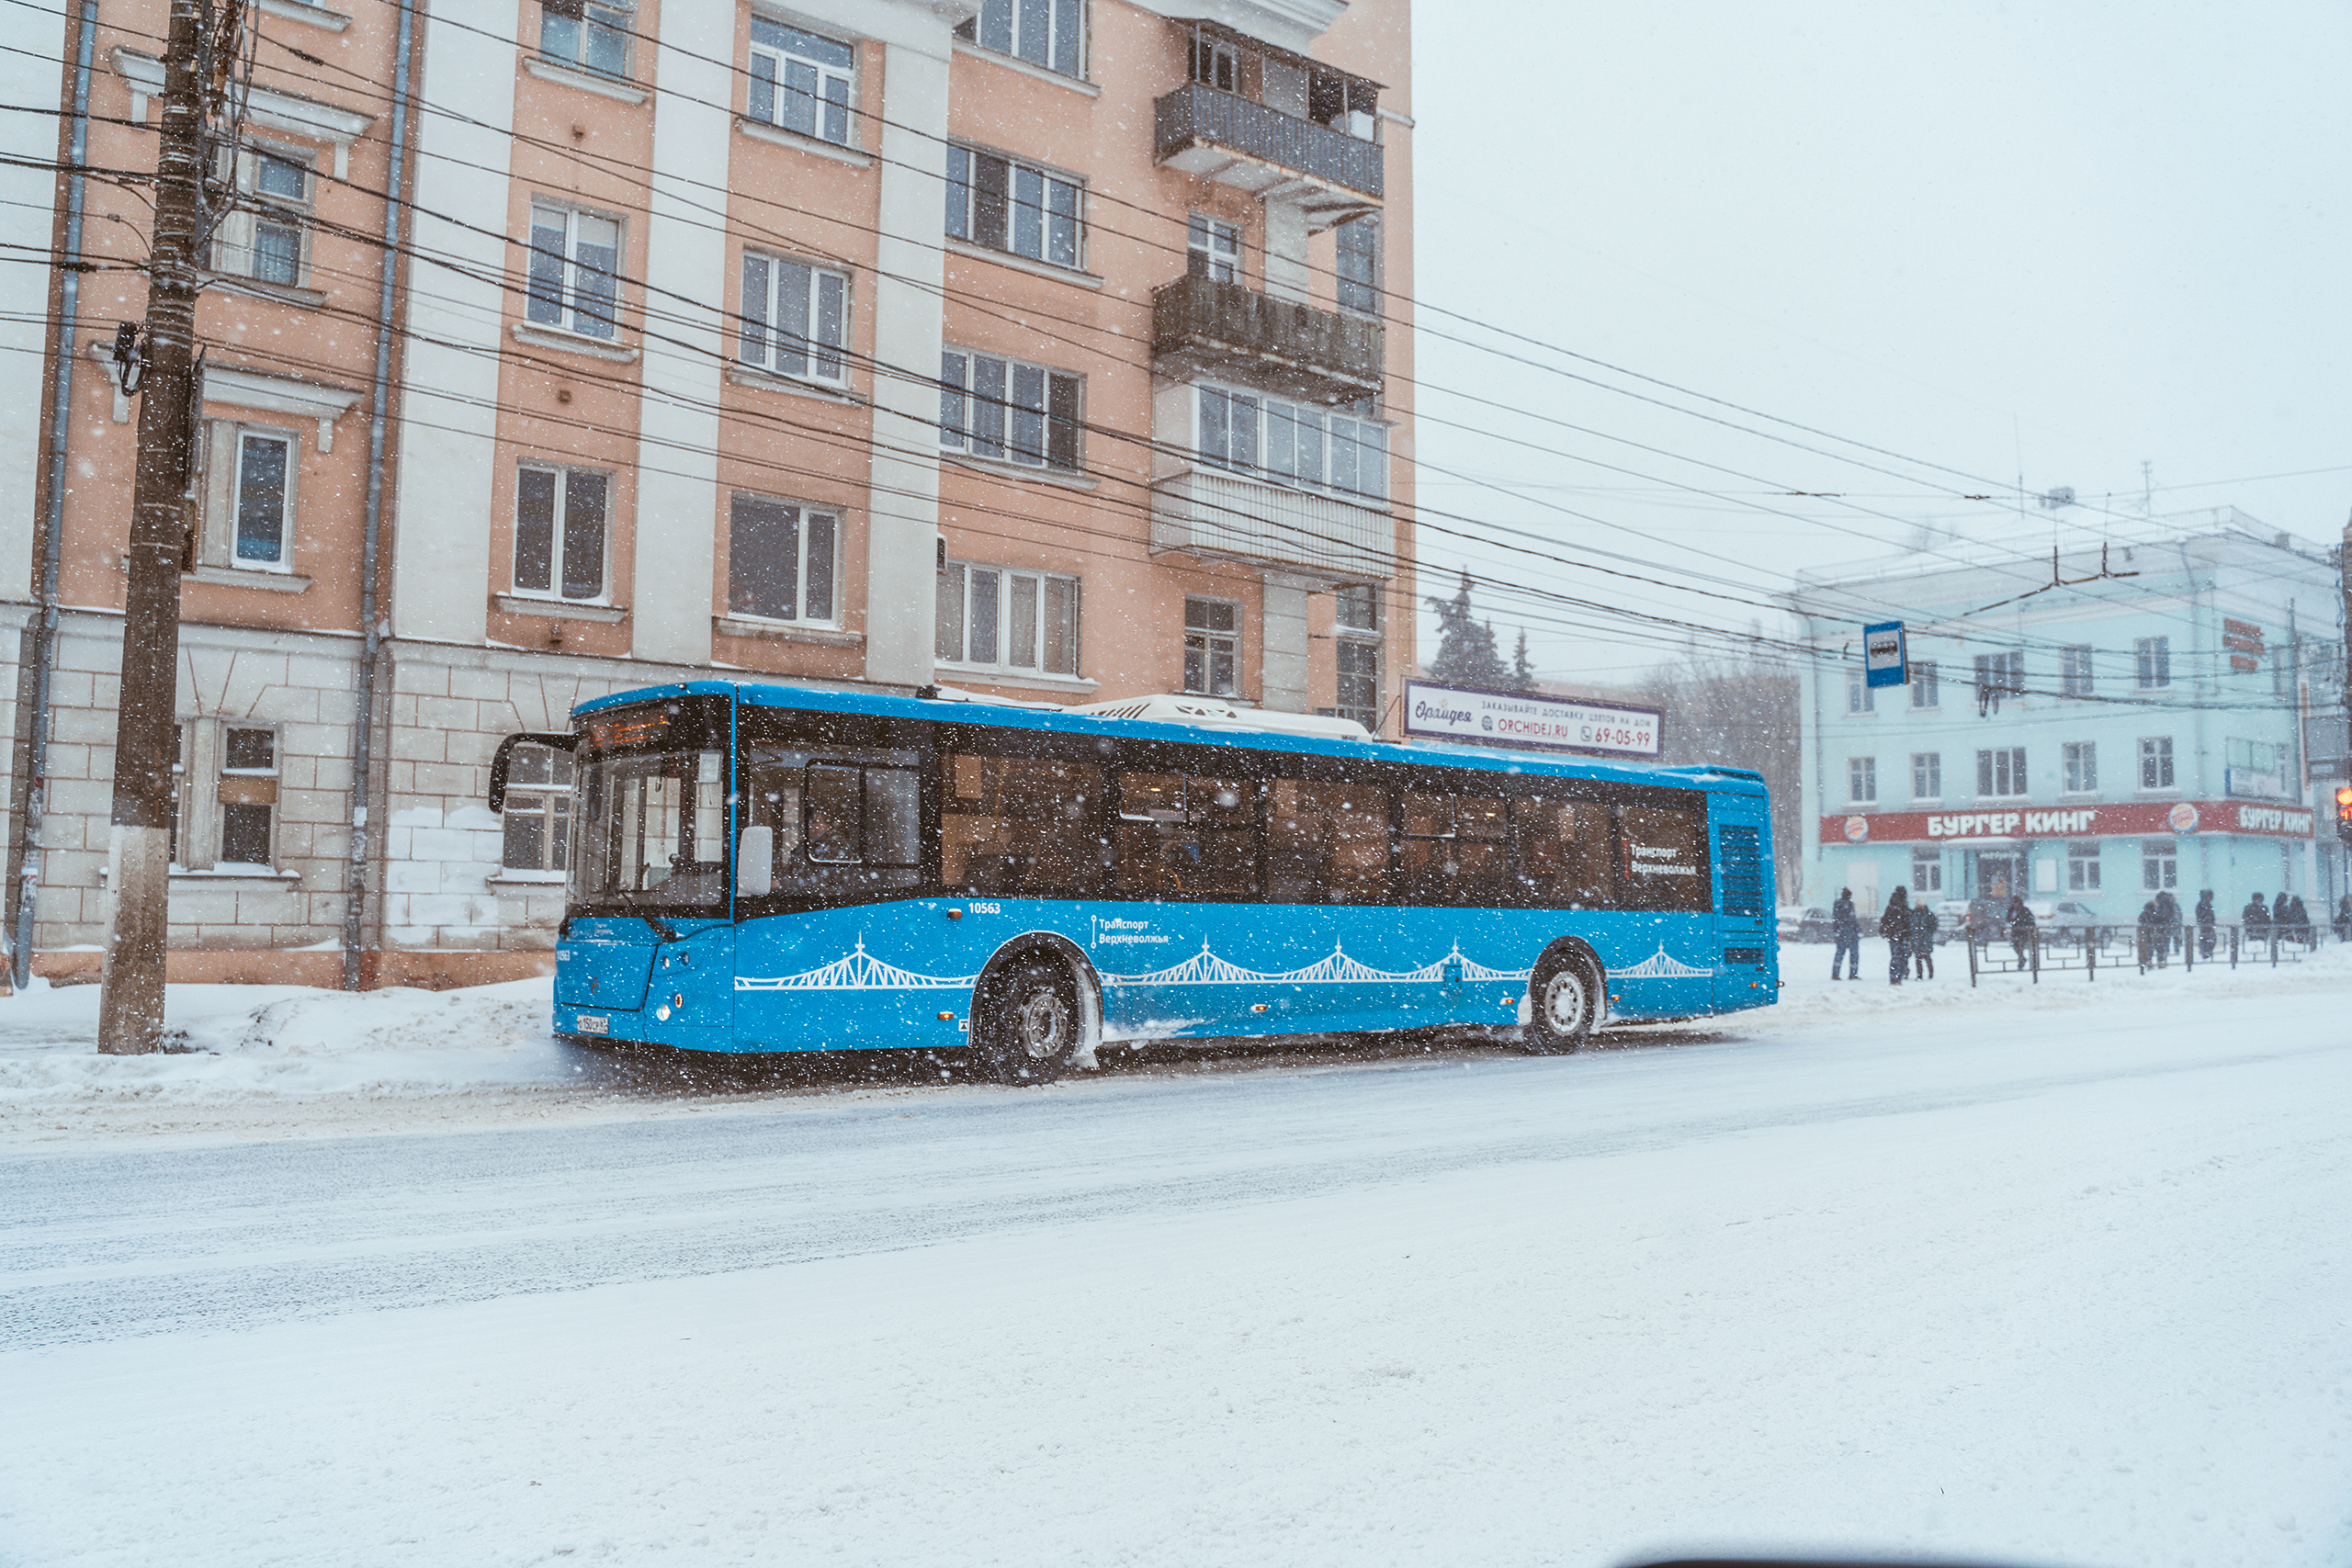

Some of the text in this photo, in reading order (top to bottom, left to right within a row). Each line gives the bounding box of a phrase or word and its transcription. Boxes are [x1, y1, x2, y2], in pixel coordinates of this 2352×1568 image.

[1481, 700, 1538, 716] ЗАКАЗЫВАЙТЕ
[1542, 708, 1584, 720] ДОСТАВКУ
[1589, 713, 1615, 724] ЦВЕТОВ
[1634, 719, 1651, 728] ДОМ
[1498, 718, 1568, 737] ORCHIDEJ.RU
[1595, 728, 1651, 747] 69-05-99
[1928, 810, 2096, 836] БУРГЕР КИНГ
[2239, 807, 2312, 833] БУРГЕР КИНГ
[1630, 843, 1678, 861] Транспорт
[1631, 860, 1697, 876] Верхневолжья
[968, 902, 1001, 915] 10563
[1099, 919, 1149, 931] Транспорт
[1099, 933, 1169, 945] Верхневолжья
